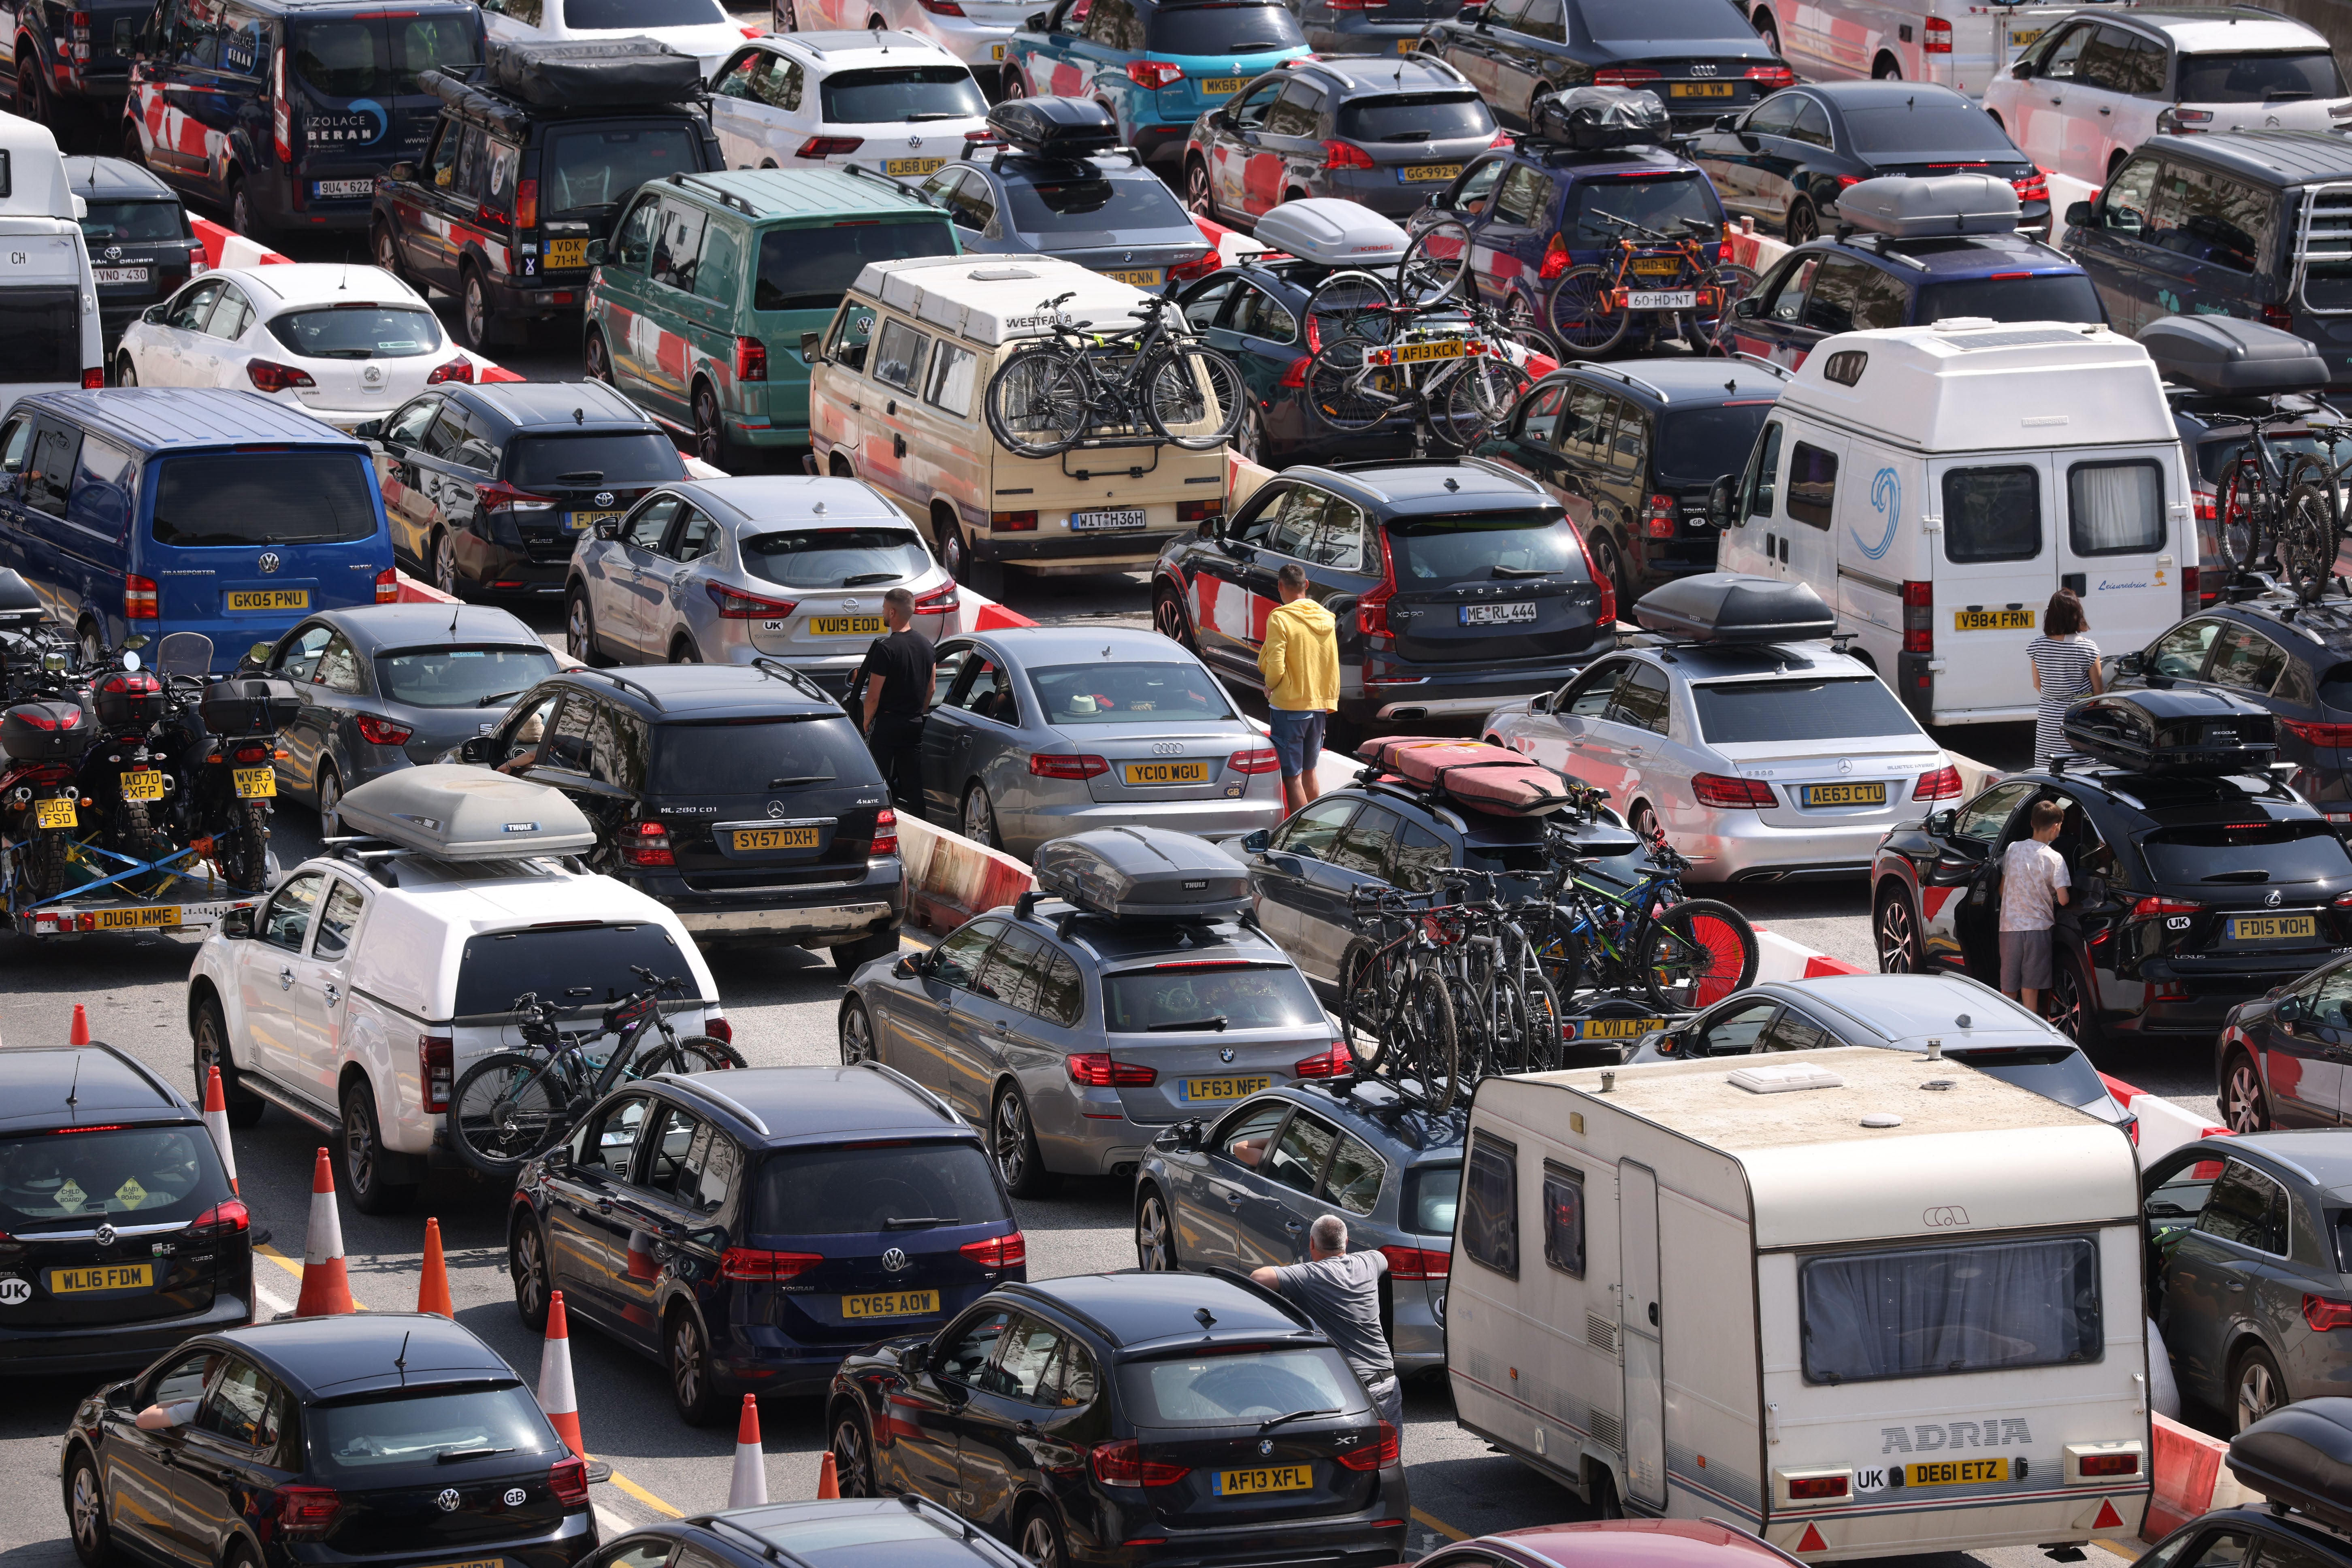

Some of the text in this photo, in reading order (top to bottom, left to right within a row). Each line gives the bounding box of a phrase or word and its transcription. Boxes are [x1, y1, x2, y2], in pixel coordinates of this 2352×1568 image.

[230, 32, 252, 49] IZOLACE
[228, 48, 251, 67] BERAN
[1207, 80, 1237, 92] MK66
[307, 116, 365, 127] IZOLACE
[307, 129, 371, 141] BERAN
[889, 162, 919, 174] GJ68
[322, 183, 342, 194] 9U4
[349, 181, 373, 193] 622
[11, 252, 26, 264] CH
[554, 255, 578, 266] 71-H
[1130, 271, 1153, 284] CNN
[1634, 295, 1690, 306] 60-HD-NT
[1006, 314, 1072, 328] WESTFALA
[1402, 343, 1459, 360] AF13 KCK
[2025, 418, 2066, 426] LEISUREDRIVE
[1079, 512, 1143, 527] WIT H36H
[1457, 585, 1539, 594] VOLVO
[2098, 580, 2147, 590] Leisuredrive
[234, 592, 302, 607] GK05 PNU
[1467, 604, 1535, 621] ME RL 444
[1961, 612, 2028, 627] V984 FRN
[765, 622, 781, 630] UK
[818, 618, 880, 632] VU19 EOD
[236, 770, 272, 783] WV53
[1135, 765, 1199, 781] YC10 WGU
[130, 785, 156, 798] XFP
[242, 782, 268, 795] BJY
[1227, 788, 1240, 796] GB
[1813, 786, 1883, 802] AE63 CTU
[44, 813, 72, 825] FSD
[423, 818, 435, 828] THULE
[740, 830, 813, 847] SY57 DXH
[103, 909, 172, 927] DU61 MME
[1577, 894, 1604, 931] TREK
[2169, 918, 2188, 928] UK
[2240, 919, 2309, 935] FD15 WOH
[1191, 1080, 1233, 1097] LF63
[63, 1268, 142, 1289] WL16 FDM
[0, 1284, 28, 1299] UK
[850, 1293, 930, 1315] CY65 AOW
[1334, 1436, 1358, 1445] X1
[1881, 1418, 2032, 1454] ADRIA
[1917, 1460, 1996, 1483] DE61 ETZ
[1229, 1468, 1306, 1491] AF13 XFL
[1858, 1469, 1884, 1489] UK
[505, 1491, 524, 1503] GB
